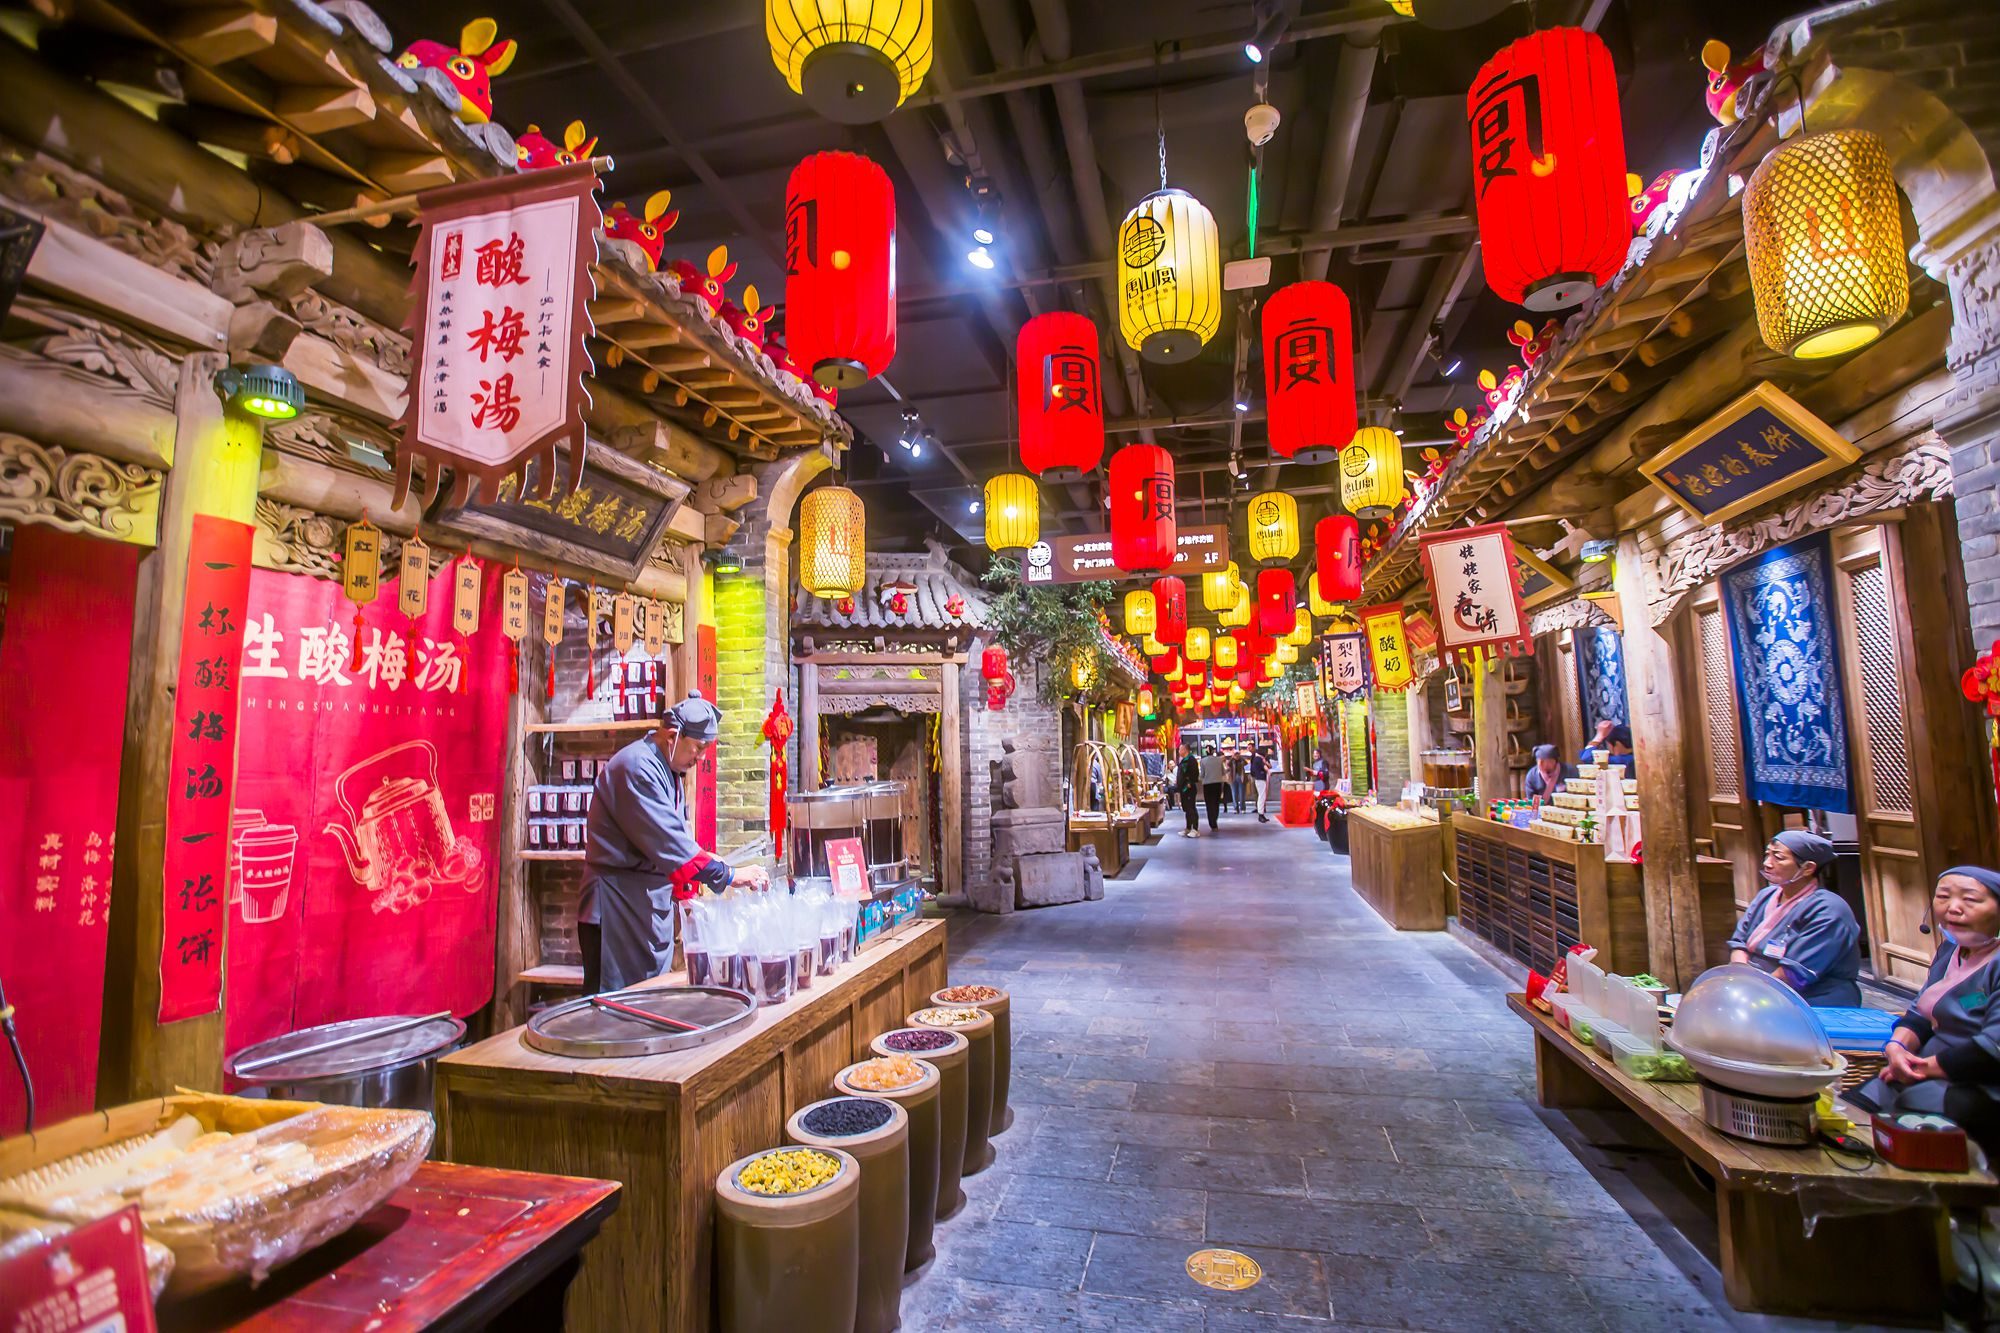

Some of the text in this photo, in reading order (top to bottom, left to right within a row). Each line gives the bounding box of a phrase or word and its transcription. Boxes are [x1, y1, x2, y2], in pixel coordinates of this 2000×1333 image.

[467, 231, 530, 433] 酸梅湯
[537, 297, 554, 369] 必打卡美食
[433, 356, 450, 414] 生津止渴
[1204, 552, 1219, 564] 1F
[1459, 544, 1482, 594] 姥姥家
[1453, 591, 1499, 634] 春饼
[1379, 635, 1400, 672] 酸奶
[177, 562, 238, 968] 一杯酸梅汤一张饼
